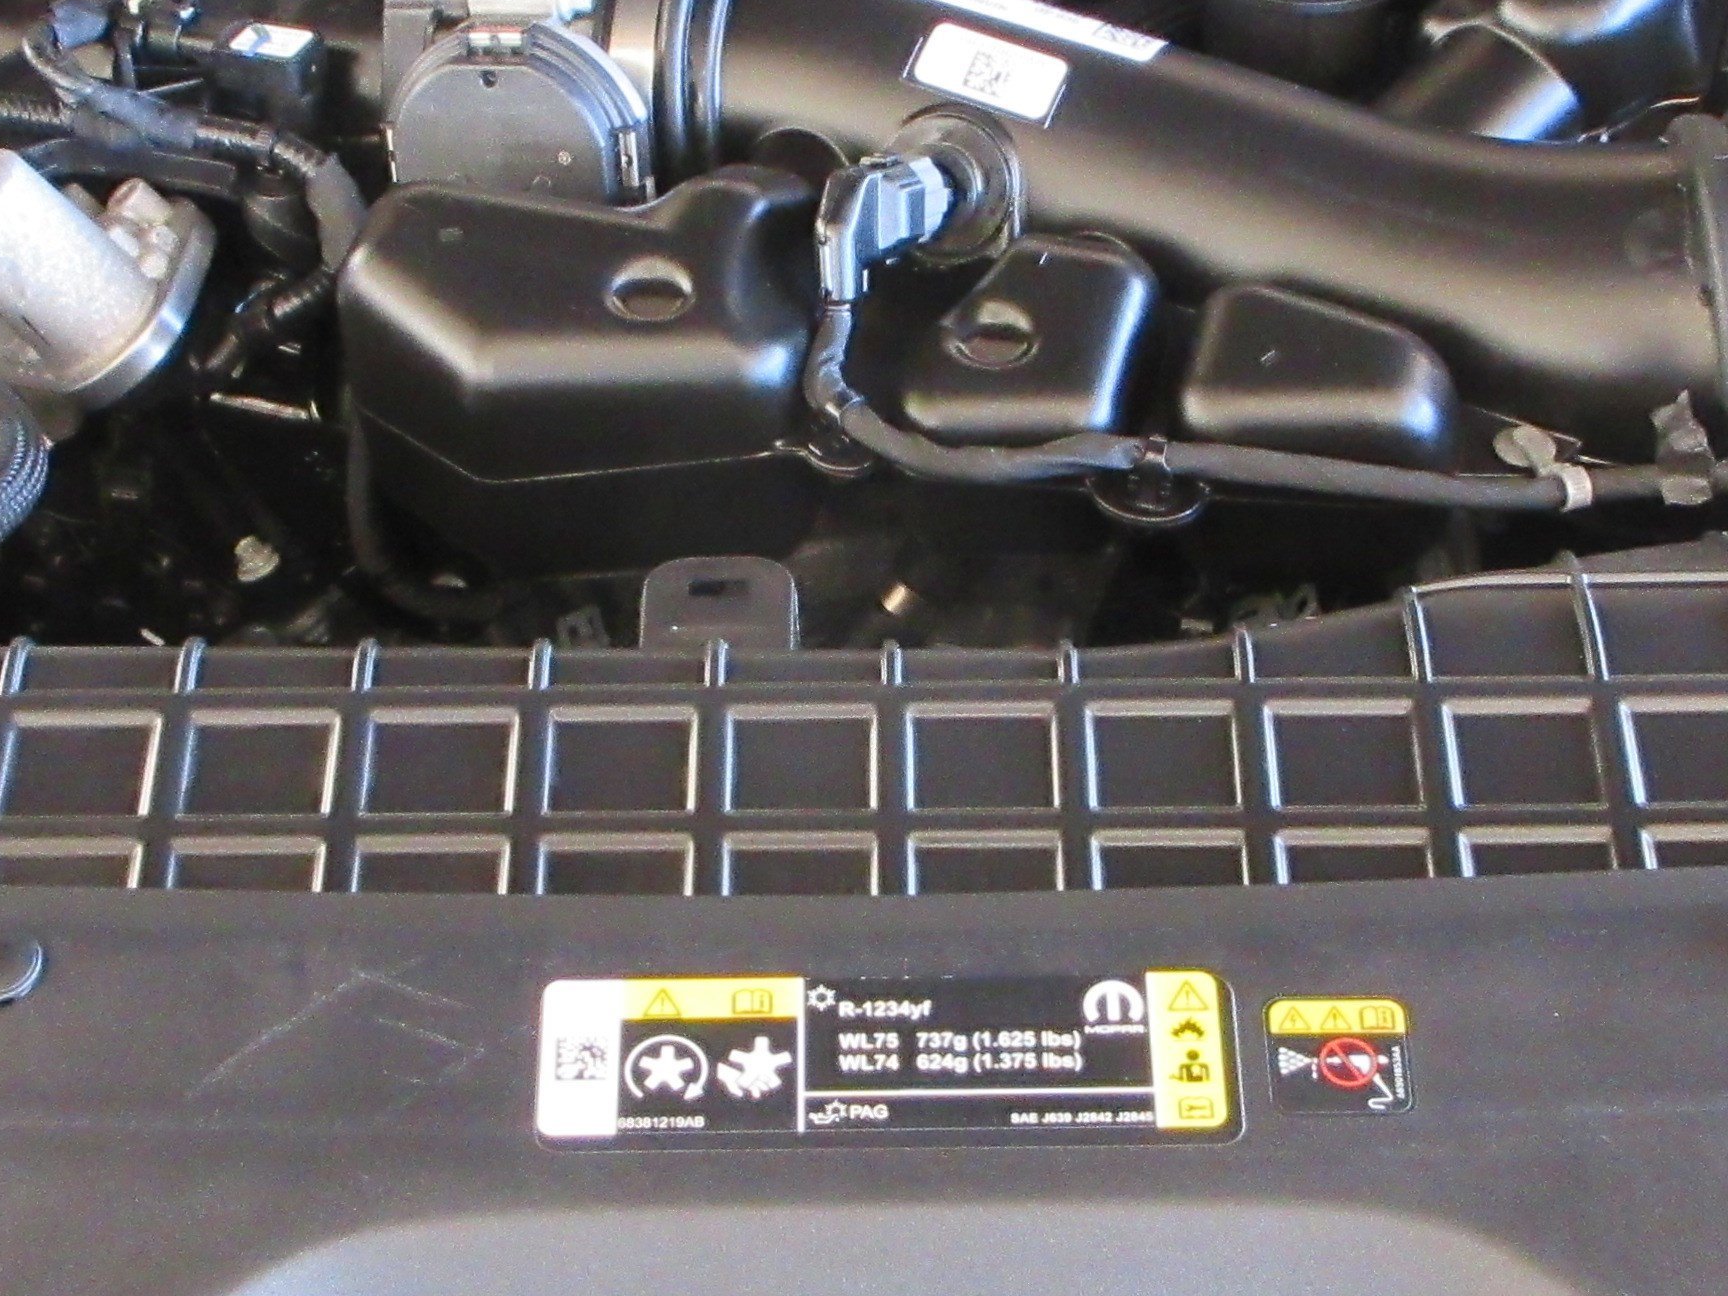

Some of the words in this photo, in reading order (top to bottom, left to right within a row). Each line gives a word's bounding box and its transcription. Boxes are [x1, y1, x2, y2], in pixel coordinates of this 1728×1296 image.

[838, 999, 932, 1020] R-1234yf
[838, 1032, 900, 1049] WL75
[916, 1031, 968, 1051] 737g
[972, 1031, 1036, 1051] (1.625
[1040, 1030, 1082, 1050] lbs)
[838, 1054, 900, 1071] WL74
[916, 1053, 969, 1074] 624g
[973, 1053, 1037, 1073] (1.375
[1041, 1052, 1083, 1072] lbs)
[849, 1104, 890, 1120] PAG
[1010, 1112, 1039, 1124] SAE
